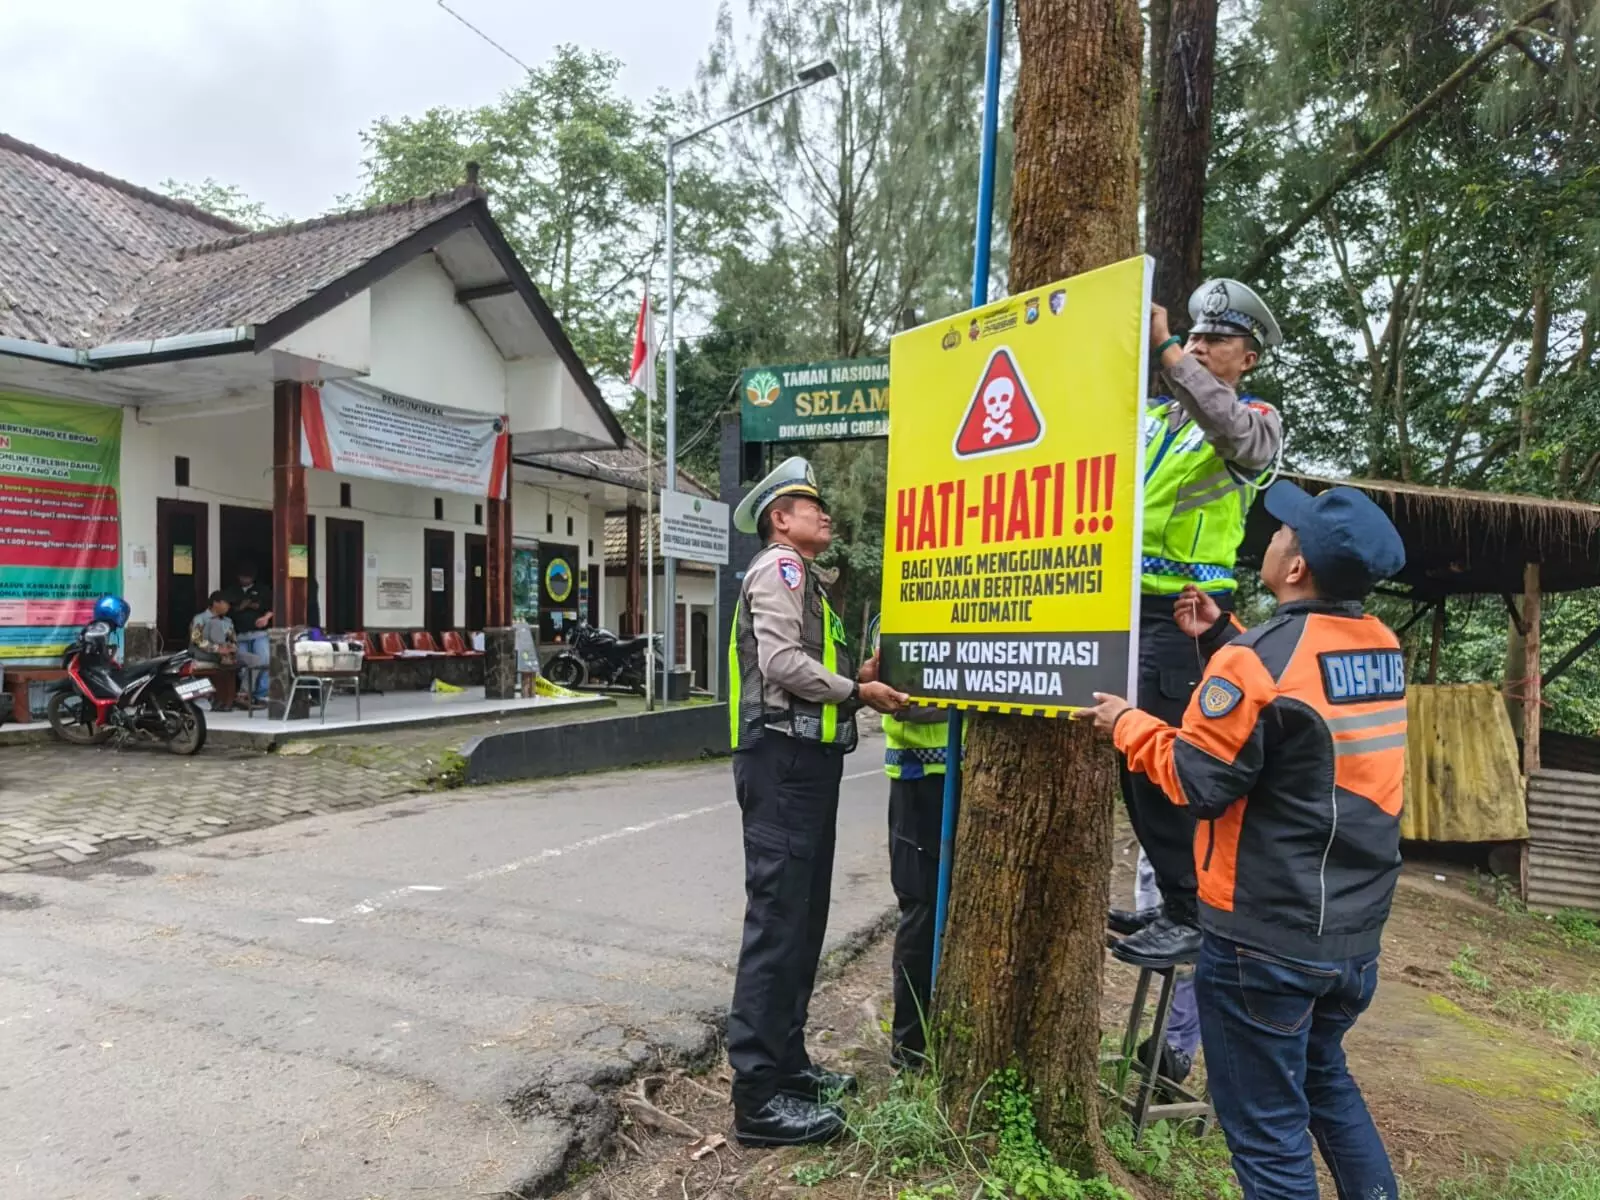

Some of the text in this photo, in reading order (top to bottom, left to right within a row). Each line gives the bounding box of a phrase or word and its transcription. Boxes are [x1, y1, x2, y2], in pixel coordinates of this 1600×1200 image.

[783, 364, 889, 388] TAMAN NASIONA
[795, 387, 890, 417] SELAM
[69, 434, 98, 444] BROMO
[779, 421, 848, 438] DIKAWASAN
[26, 466, 50, 475] YANG
[896, 453, 1116, 552] HATI-HATI !!!
[901, 543, 1102, 580] BAGI YANG MENGGUNAKAN
[900, 570, 1103, 602] KENDARAAN BERTRANSMISI
[951, 600, 1032, 623] AUTOMATIC
[899, 641, 1099, 666] TETAP KONSENTRASI
[923, 668, 1063, 696] DAN WASPADA
[1325, 654, 1405, 697] DISHUB
